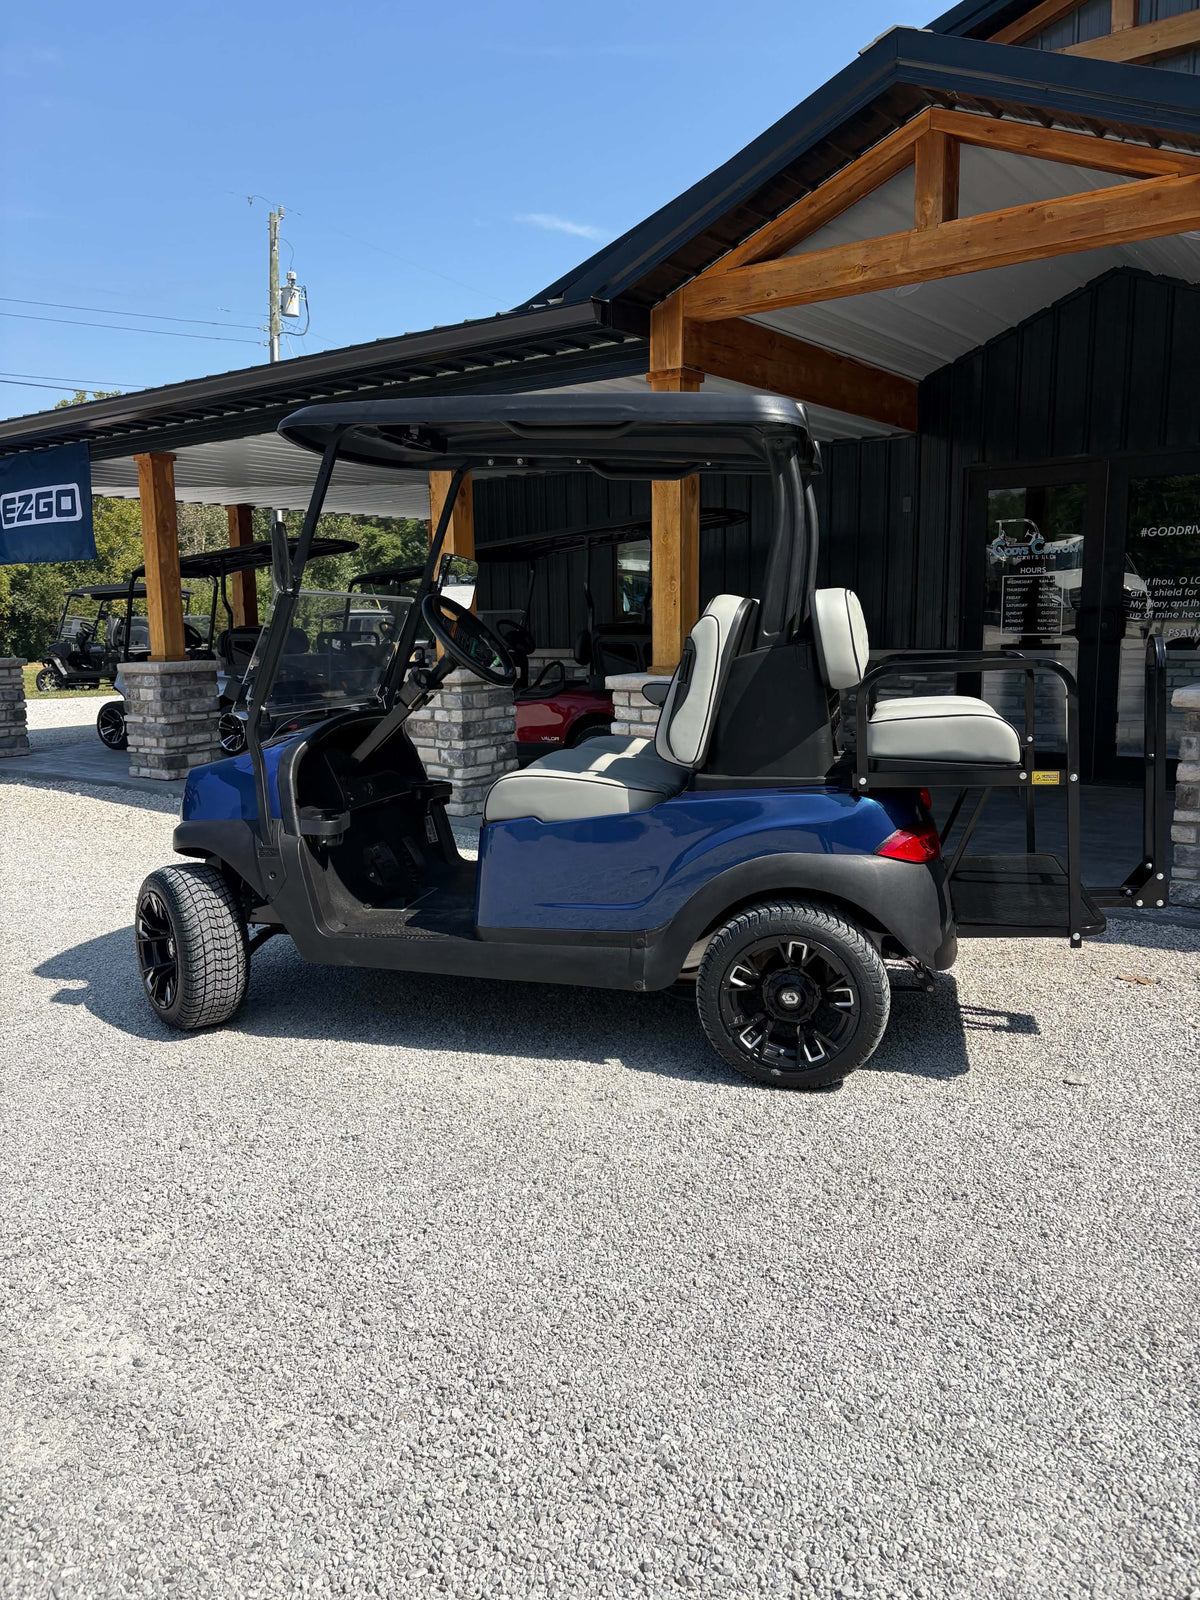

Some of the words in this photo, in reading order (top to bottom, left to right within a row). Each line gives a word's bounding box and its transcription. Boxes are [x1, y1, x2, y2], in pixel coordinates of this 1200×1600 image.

[2, 488, 78, 525] EZGO
[1031, 539, 1080, 554] CUSTOM
[1020, 566, 1047, 574] HOURS
[1179, 576, 1188, 585] O
[1154, 588, 1183, 597] shield
[1184, 587, 1198, 596] for
[1130, 600, 1144, 609] My
[1171, 599, 1190, 608] and
[1155, 610, 1180, 619] mine
